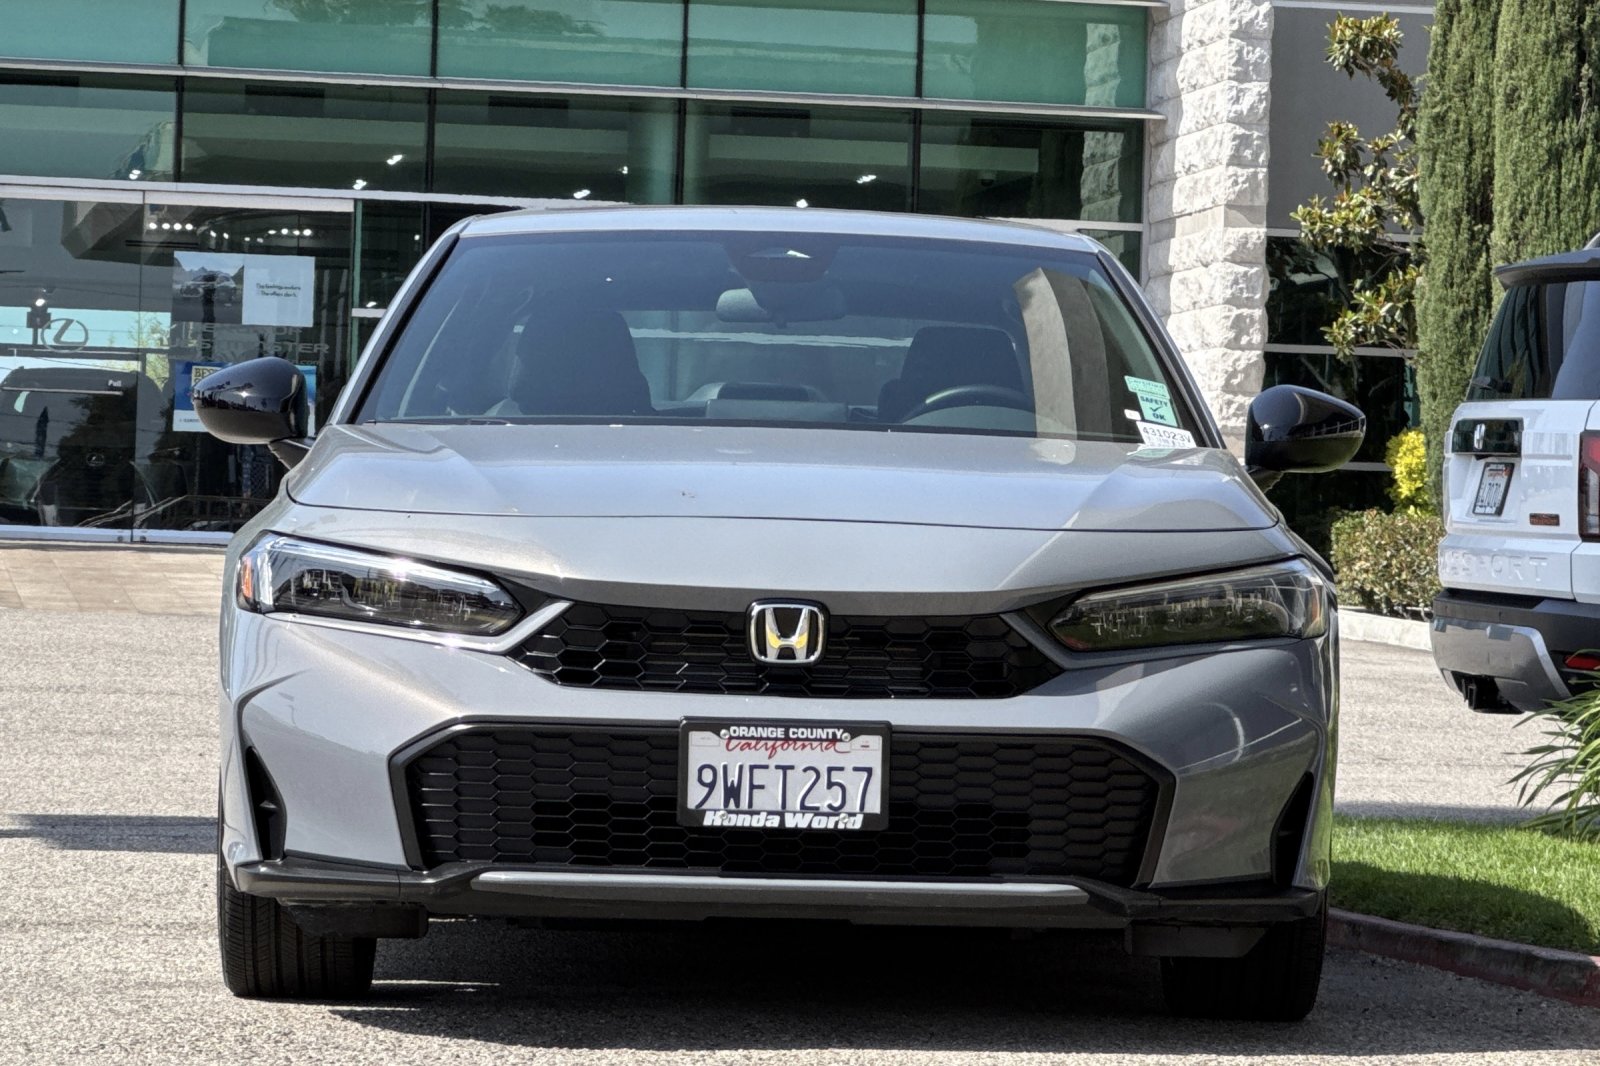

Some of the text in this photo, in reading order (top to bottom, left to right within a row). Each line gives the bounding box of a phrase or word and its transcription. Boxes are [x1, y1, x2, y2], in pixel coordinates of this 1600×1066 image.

[1140, 395, 1168, 407] SAFETY
[1152, 412, 1166, 421] OK
[729, 726, 844, 740] ORANGE COUNTY
[725, 737, 851, 759] California
[695, 763, 873, 812] 9WFT257
[702, 810, 864, 830] Honda World
